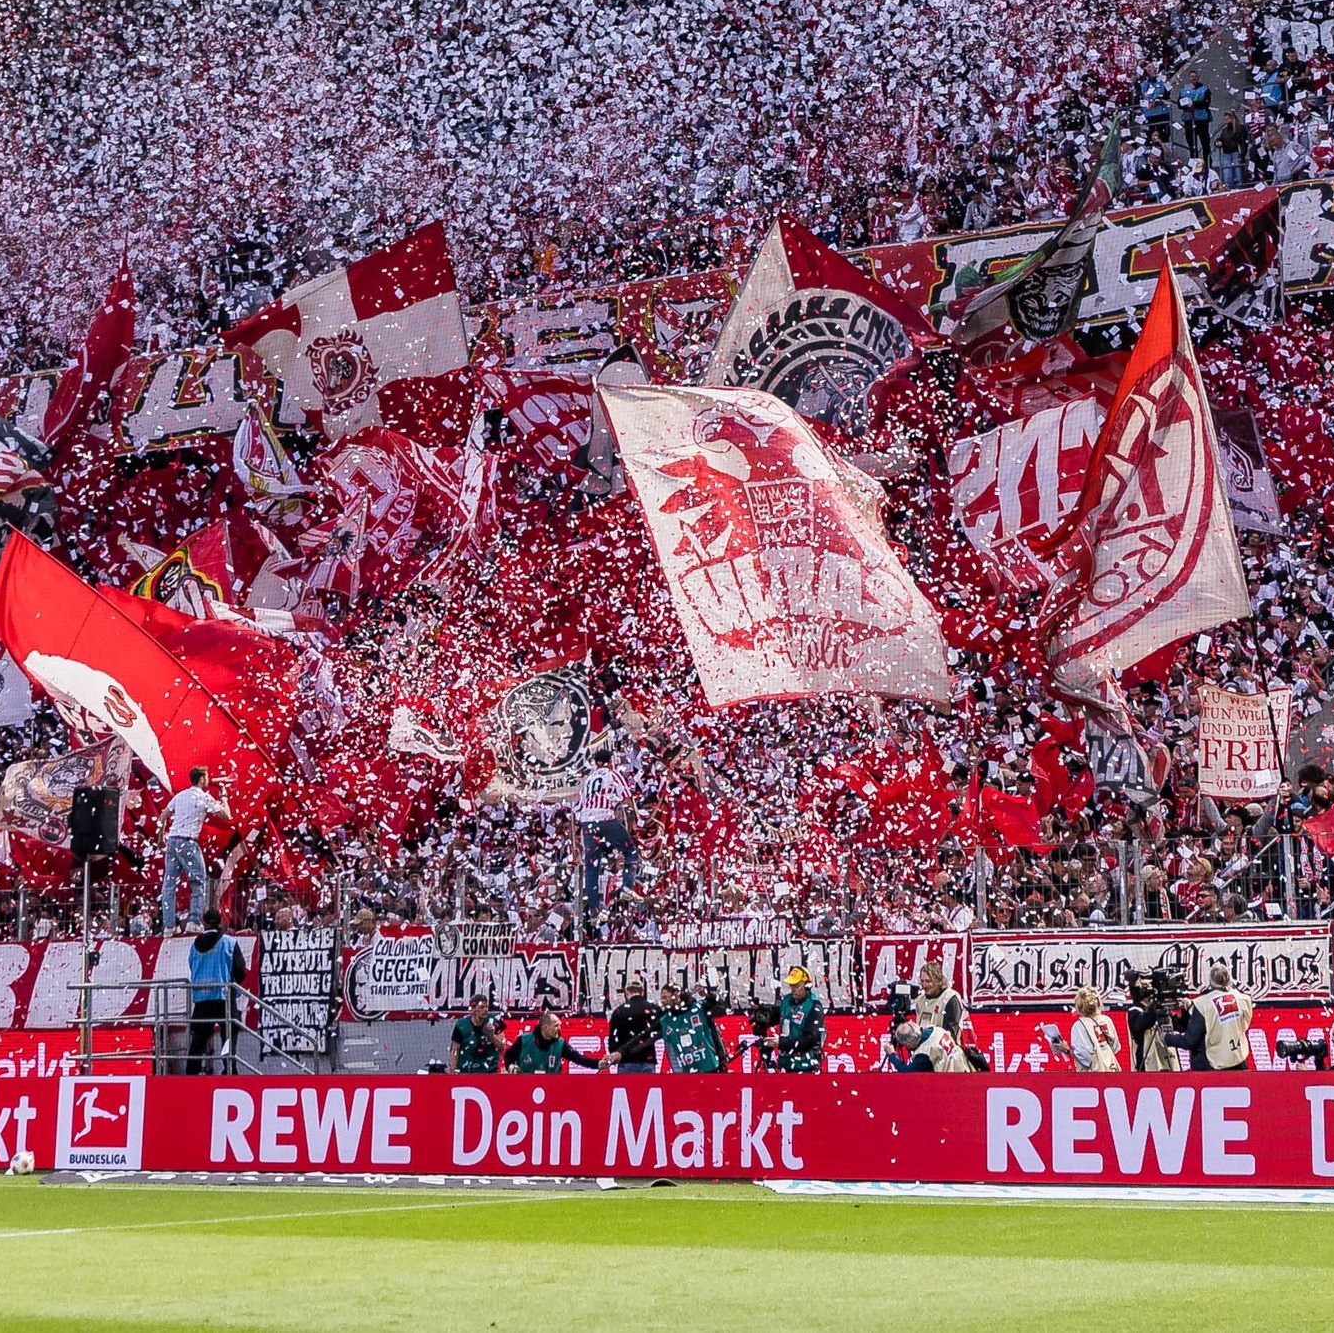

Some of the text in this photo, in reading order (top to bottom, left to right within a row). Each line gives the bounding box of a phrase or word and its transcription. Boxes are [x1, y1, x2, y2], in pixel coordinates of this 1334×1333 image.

[1202, 707, 1285, 722] TUN WILLT
[1202, 723, 1233, 736] UND
[1201, 738, 1282, 771] FREI
[374, 936, 433, 957] COLONIACS
[463, 938, 488, 956] CON
[372, 957, 431, 983] GEGEN
[973, 945, 1130, 995] Kölsche
[262, 973, 320, 995] TRIBUNE
[676, 1047, 706, 1068] HOST
[210, 1085, 805, 1170] REWE Dein Markt
[986, 1085, 1257, 1176] REWE
[69, 1153, 127, 1165] BUNDESLIGA
